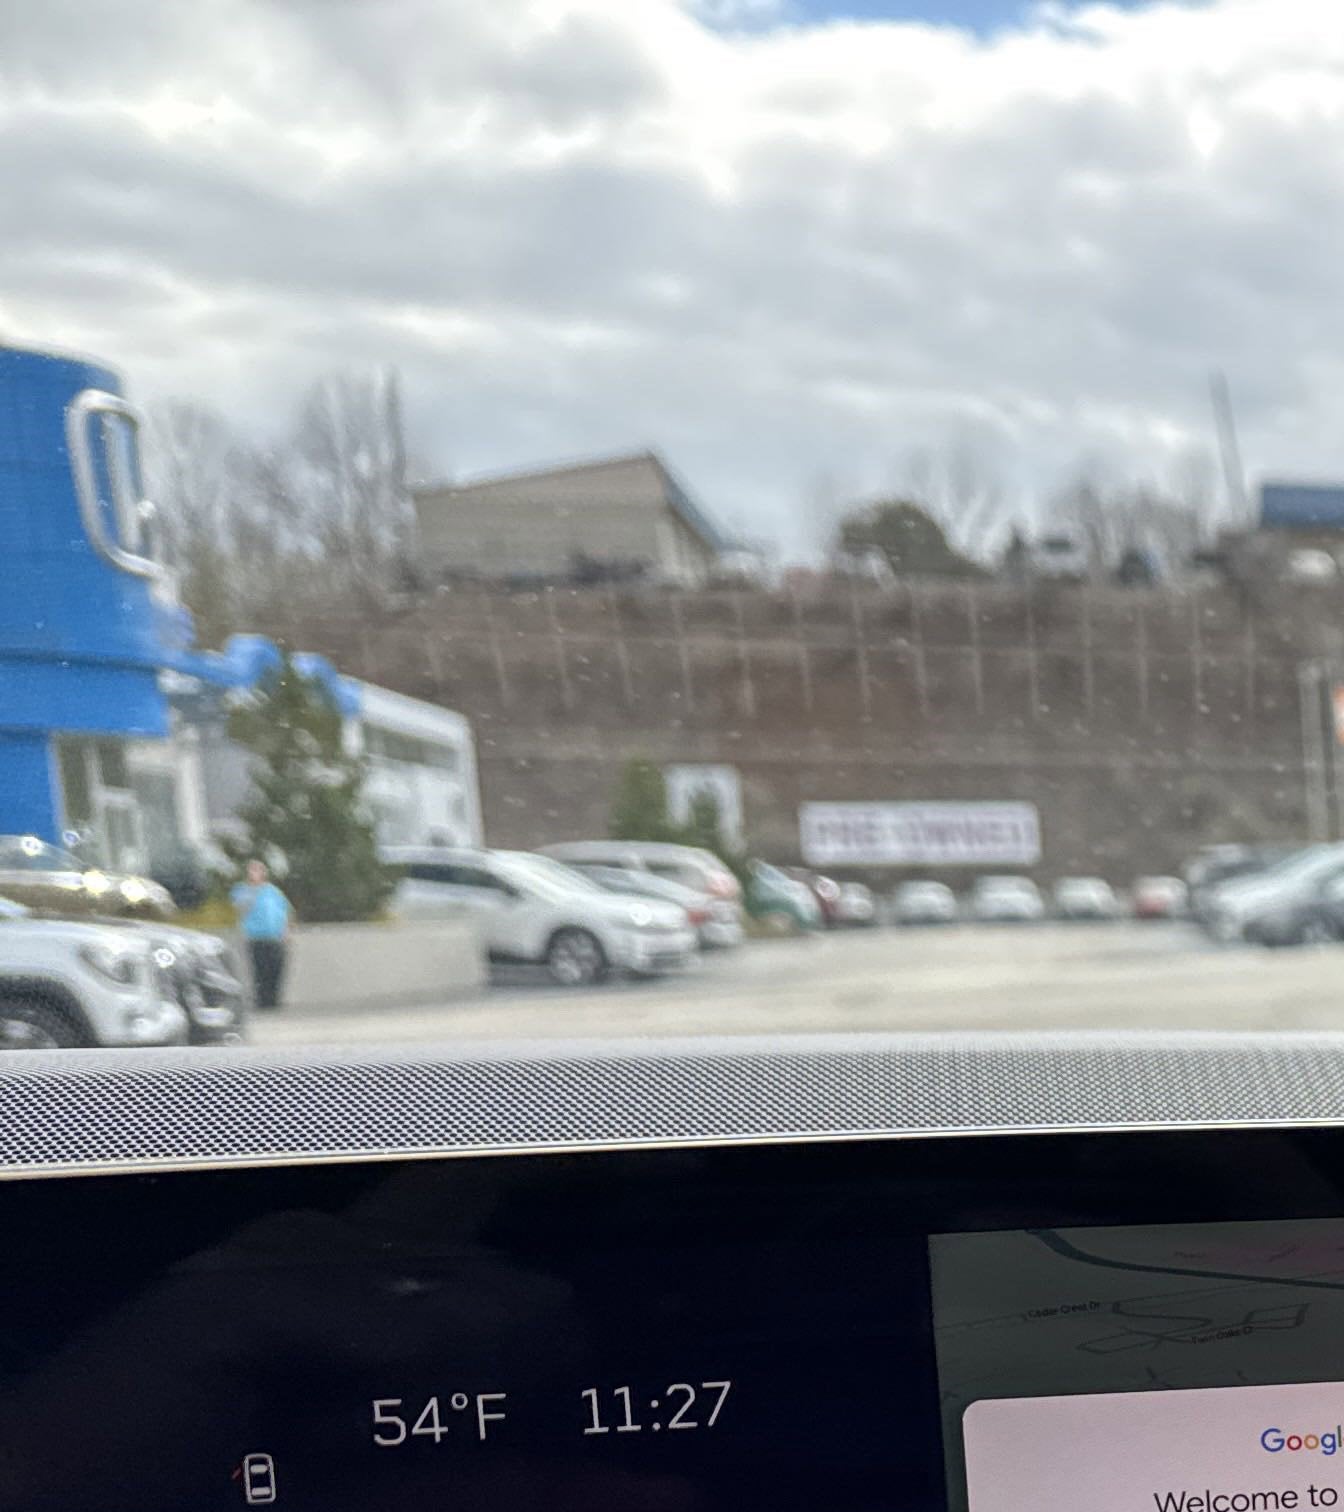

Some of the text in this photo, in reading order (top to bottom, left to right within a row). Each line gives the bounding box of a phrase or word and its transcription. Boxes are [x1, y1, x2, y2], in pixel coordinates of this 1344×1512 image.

[374, 1393, 506, 1445] 54°F
[582, 1381, 730, 1433] 11:27
[1307, 1485, 1337, 1506] to
